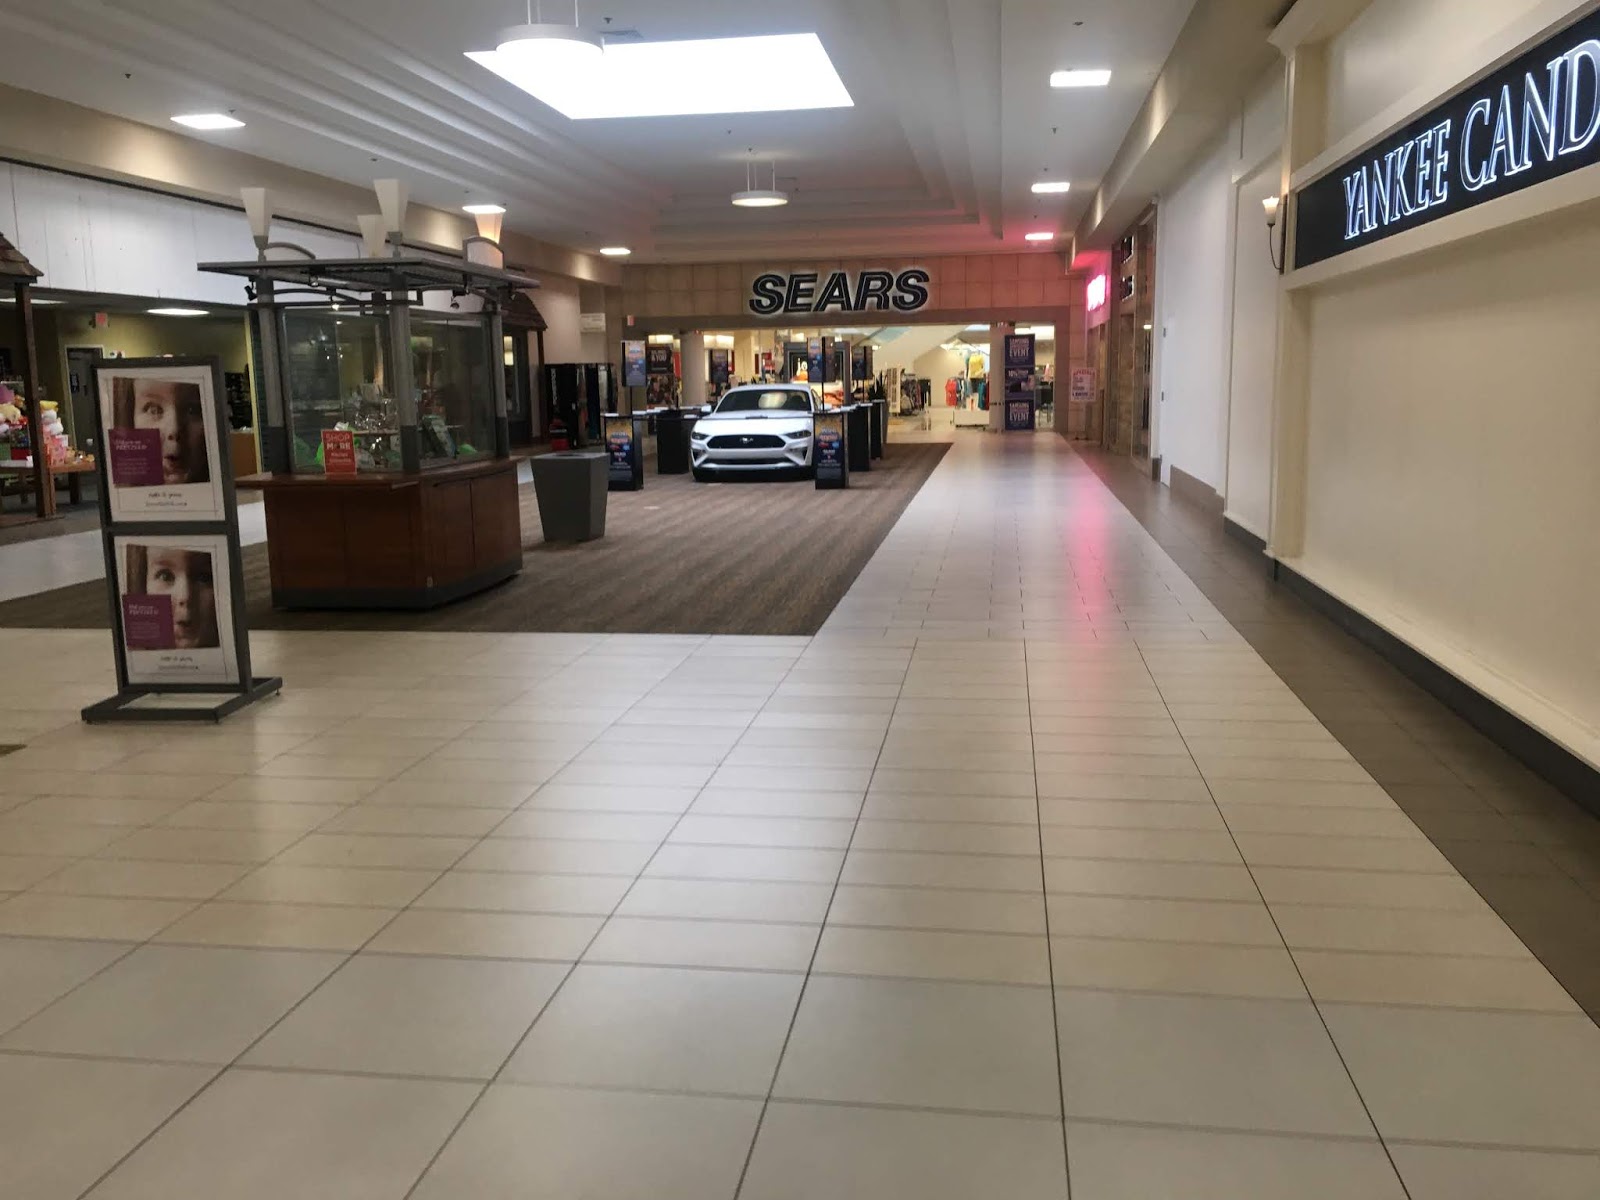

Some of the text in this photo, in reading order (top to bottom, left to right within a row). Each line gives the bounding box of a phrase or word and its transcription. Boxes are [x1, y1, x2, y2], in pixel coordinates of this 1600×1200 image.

[1343, 38, 1600, 240] YANKEE CAND
[749, 270, 930, 315] SEARS
[1009, 347, 1029, 357] EVENT
[1009, 412, 1029, 421] EVENT
[325, 433, 351, 442] SHOP
